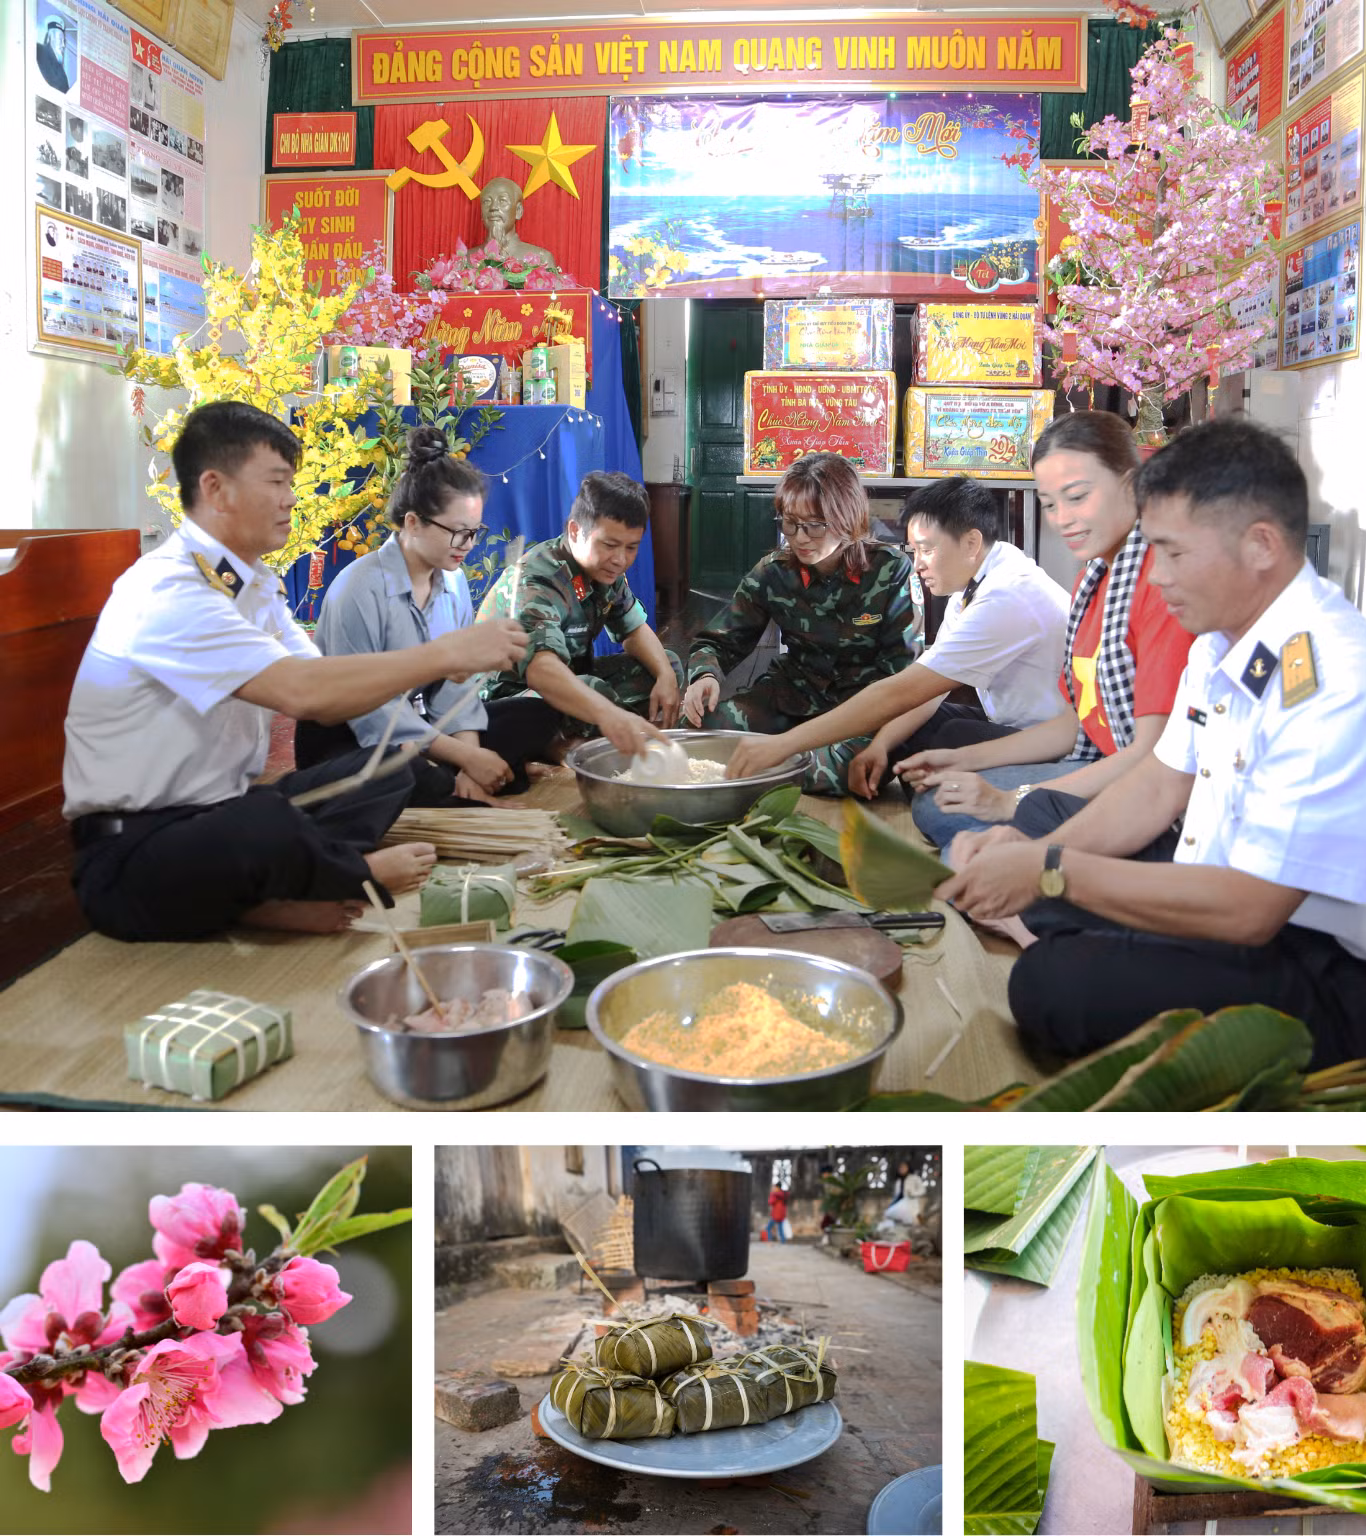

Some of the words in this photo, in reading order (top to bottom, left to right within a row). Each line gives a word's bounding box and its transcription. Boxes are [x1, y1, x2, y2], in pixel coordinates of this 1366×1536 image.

[373, 40, 442, 84] ĐẢNG
[452, 40, 521, 88] CỘNG
[530, 33, 583, 77] SẢN
[595, 34, 649, 81] VIỆT
[659, 39, 721, 72] NAM
[733, 37, 822, 75] QUANG
[834, 36, 895, 69] VINH
[907, 29, 986, 70] MUÔN
[998, 29, 1062, 70] NĂM
[280, 133, 291, 154] CHI
[291, 128, 300, 160] BỘ
[301, 128, 313, 154] NHÀ
[329, 132, 350, 155] DK1/10
[903, 111, 963, 159] Mới
[295, 185, 332, 209] SUỐT
[335, 185, 360, 208] ĐỜI
[321, 215, 355, 234] SINH
[333, 236, 363, 260] ĐẤU
[472, 308, 522, 345] Năm
